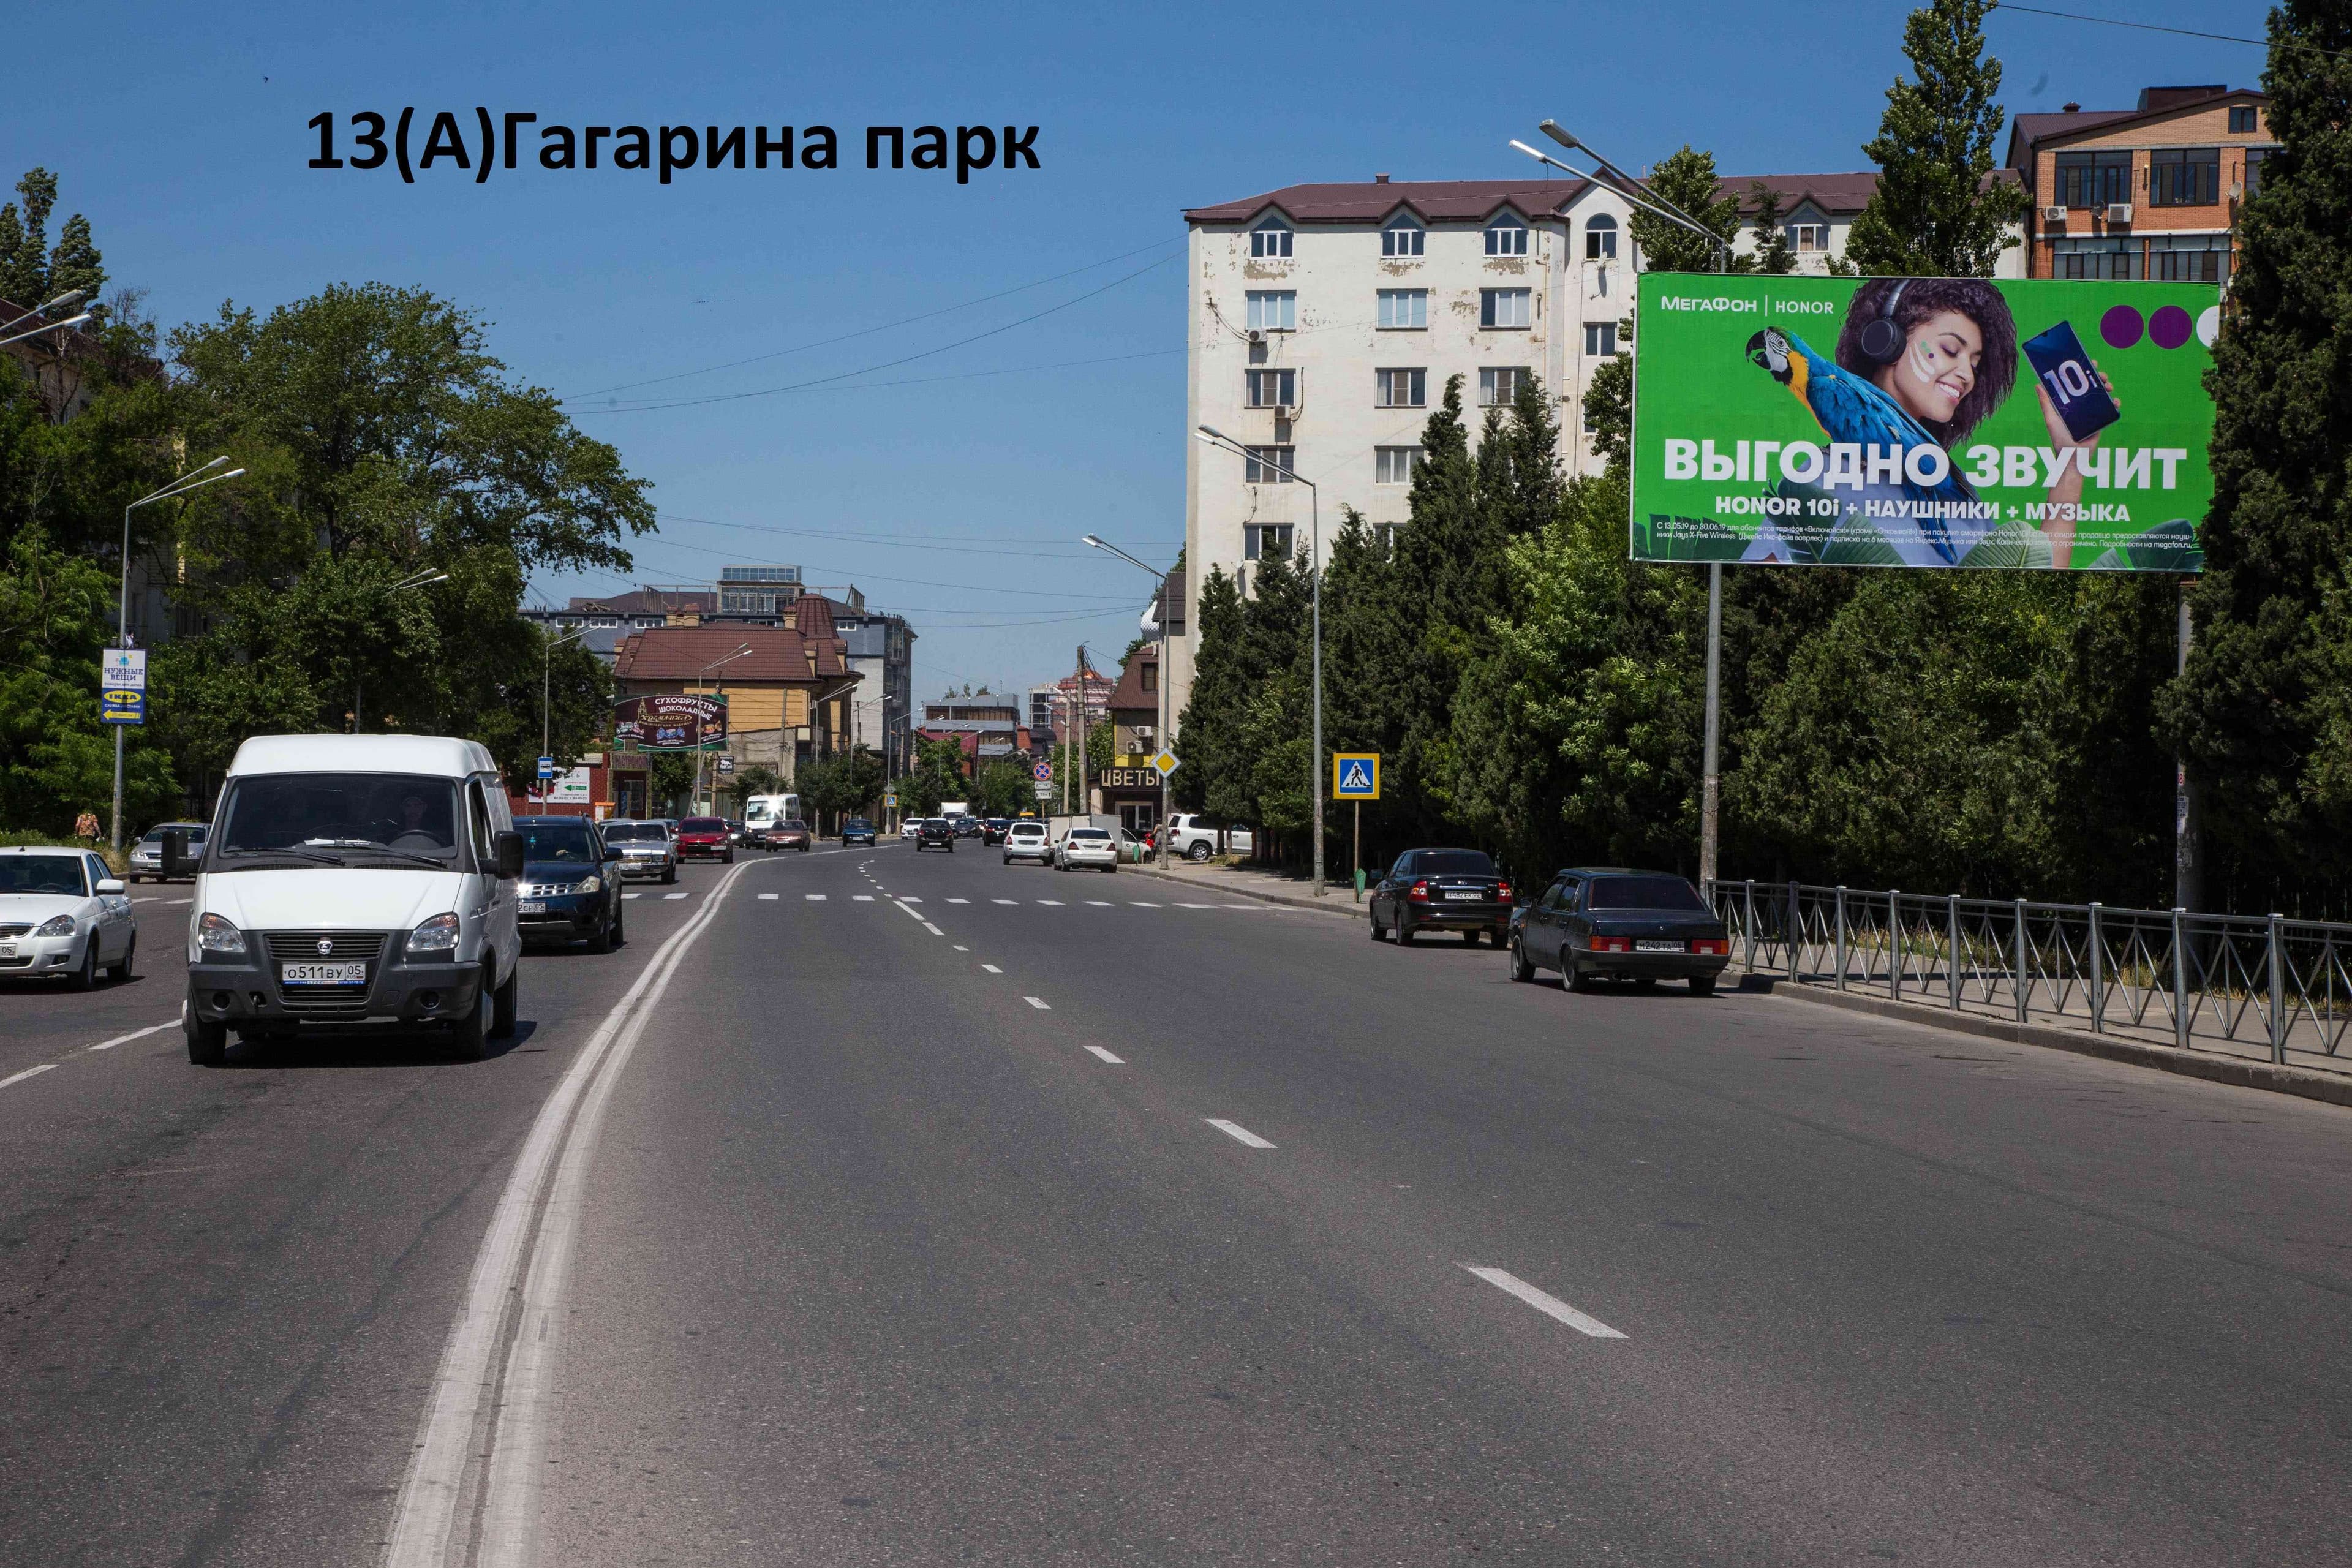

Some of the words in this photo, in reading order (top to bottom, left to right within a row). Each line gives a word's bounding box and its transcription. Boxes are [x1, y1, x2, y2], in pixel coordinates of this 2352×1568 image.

[1776, 300, 1834, 314] HONOR
[2043, 360, 2098, 405] 10i
[1664, 438, 1950, 491] ВЫГОДНО
[1965, 444, 2187, 489] ЗВУЧИТ
[1715, 496, 1801, 516] HONOR
[1807, 499, 1839, 517] 10i
[1864, 499, 1999, 519] НАУШНИКИ
[2025, 502, 2131, 522] МУЗЫКА
[1673, 531, 1689, 540] Jays
[655, 696, 718, 713] СУХОФРУКТЫ
[1102, 769, 1159, 788] ЦВЕТЫ
[1638, 941, 1672, 951] М242ТА
[288, 965, 343, 979] О511ВУ
[347, 965, 361, 975] 05
